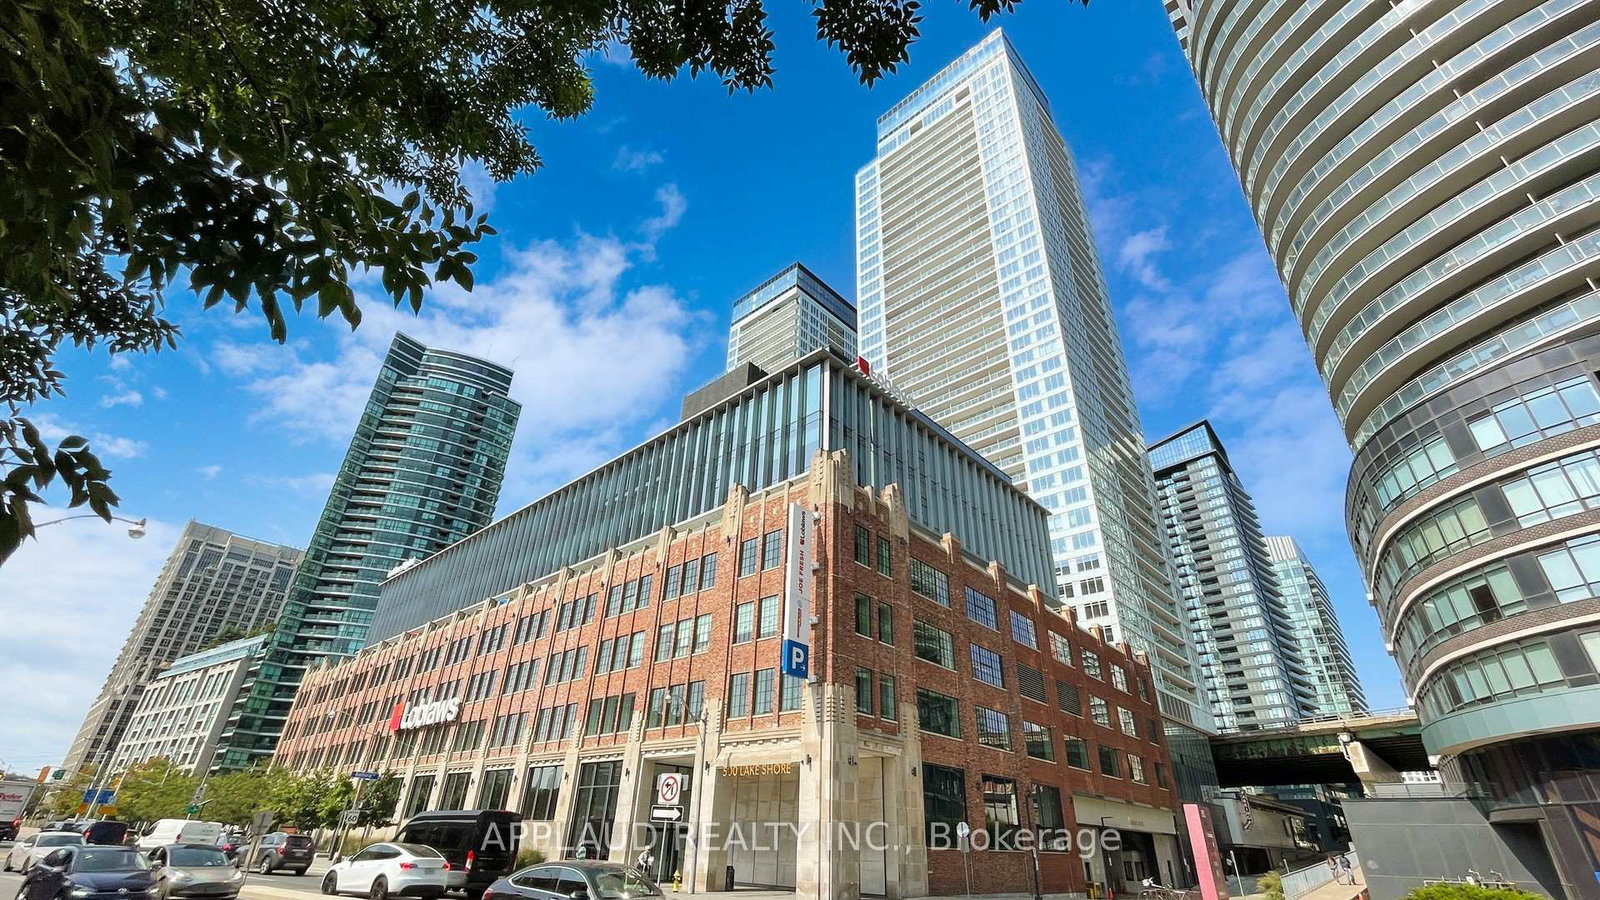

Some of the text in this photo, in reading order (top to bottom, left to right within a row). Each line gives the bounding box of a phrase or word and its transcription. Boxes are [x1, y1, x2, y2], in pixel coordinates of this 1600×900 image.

[792, 647, 804, 669] P
[400, 697, 460, 729] Loblaws
[740, 764, 760, 776] LAKE
[761, 763, 791, 775] SHORE
